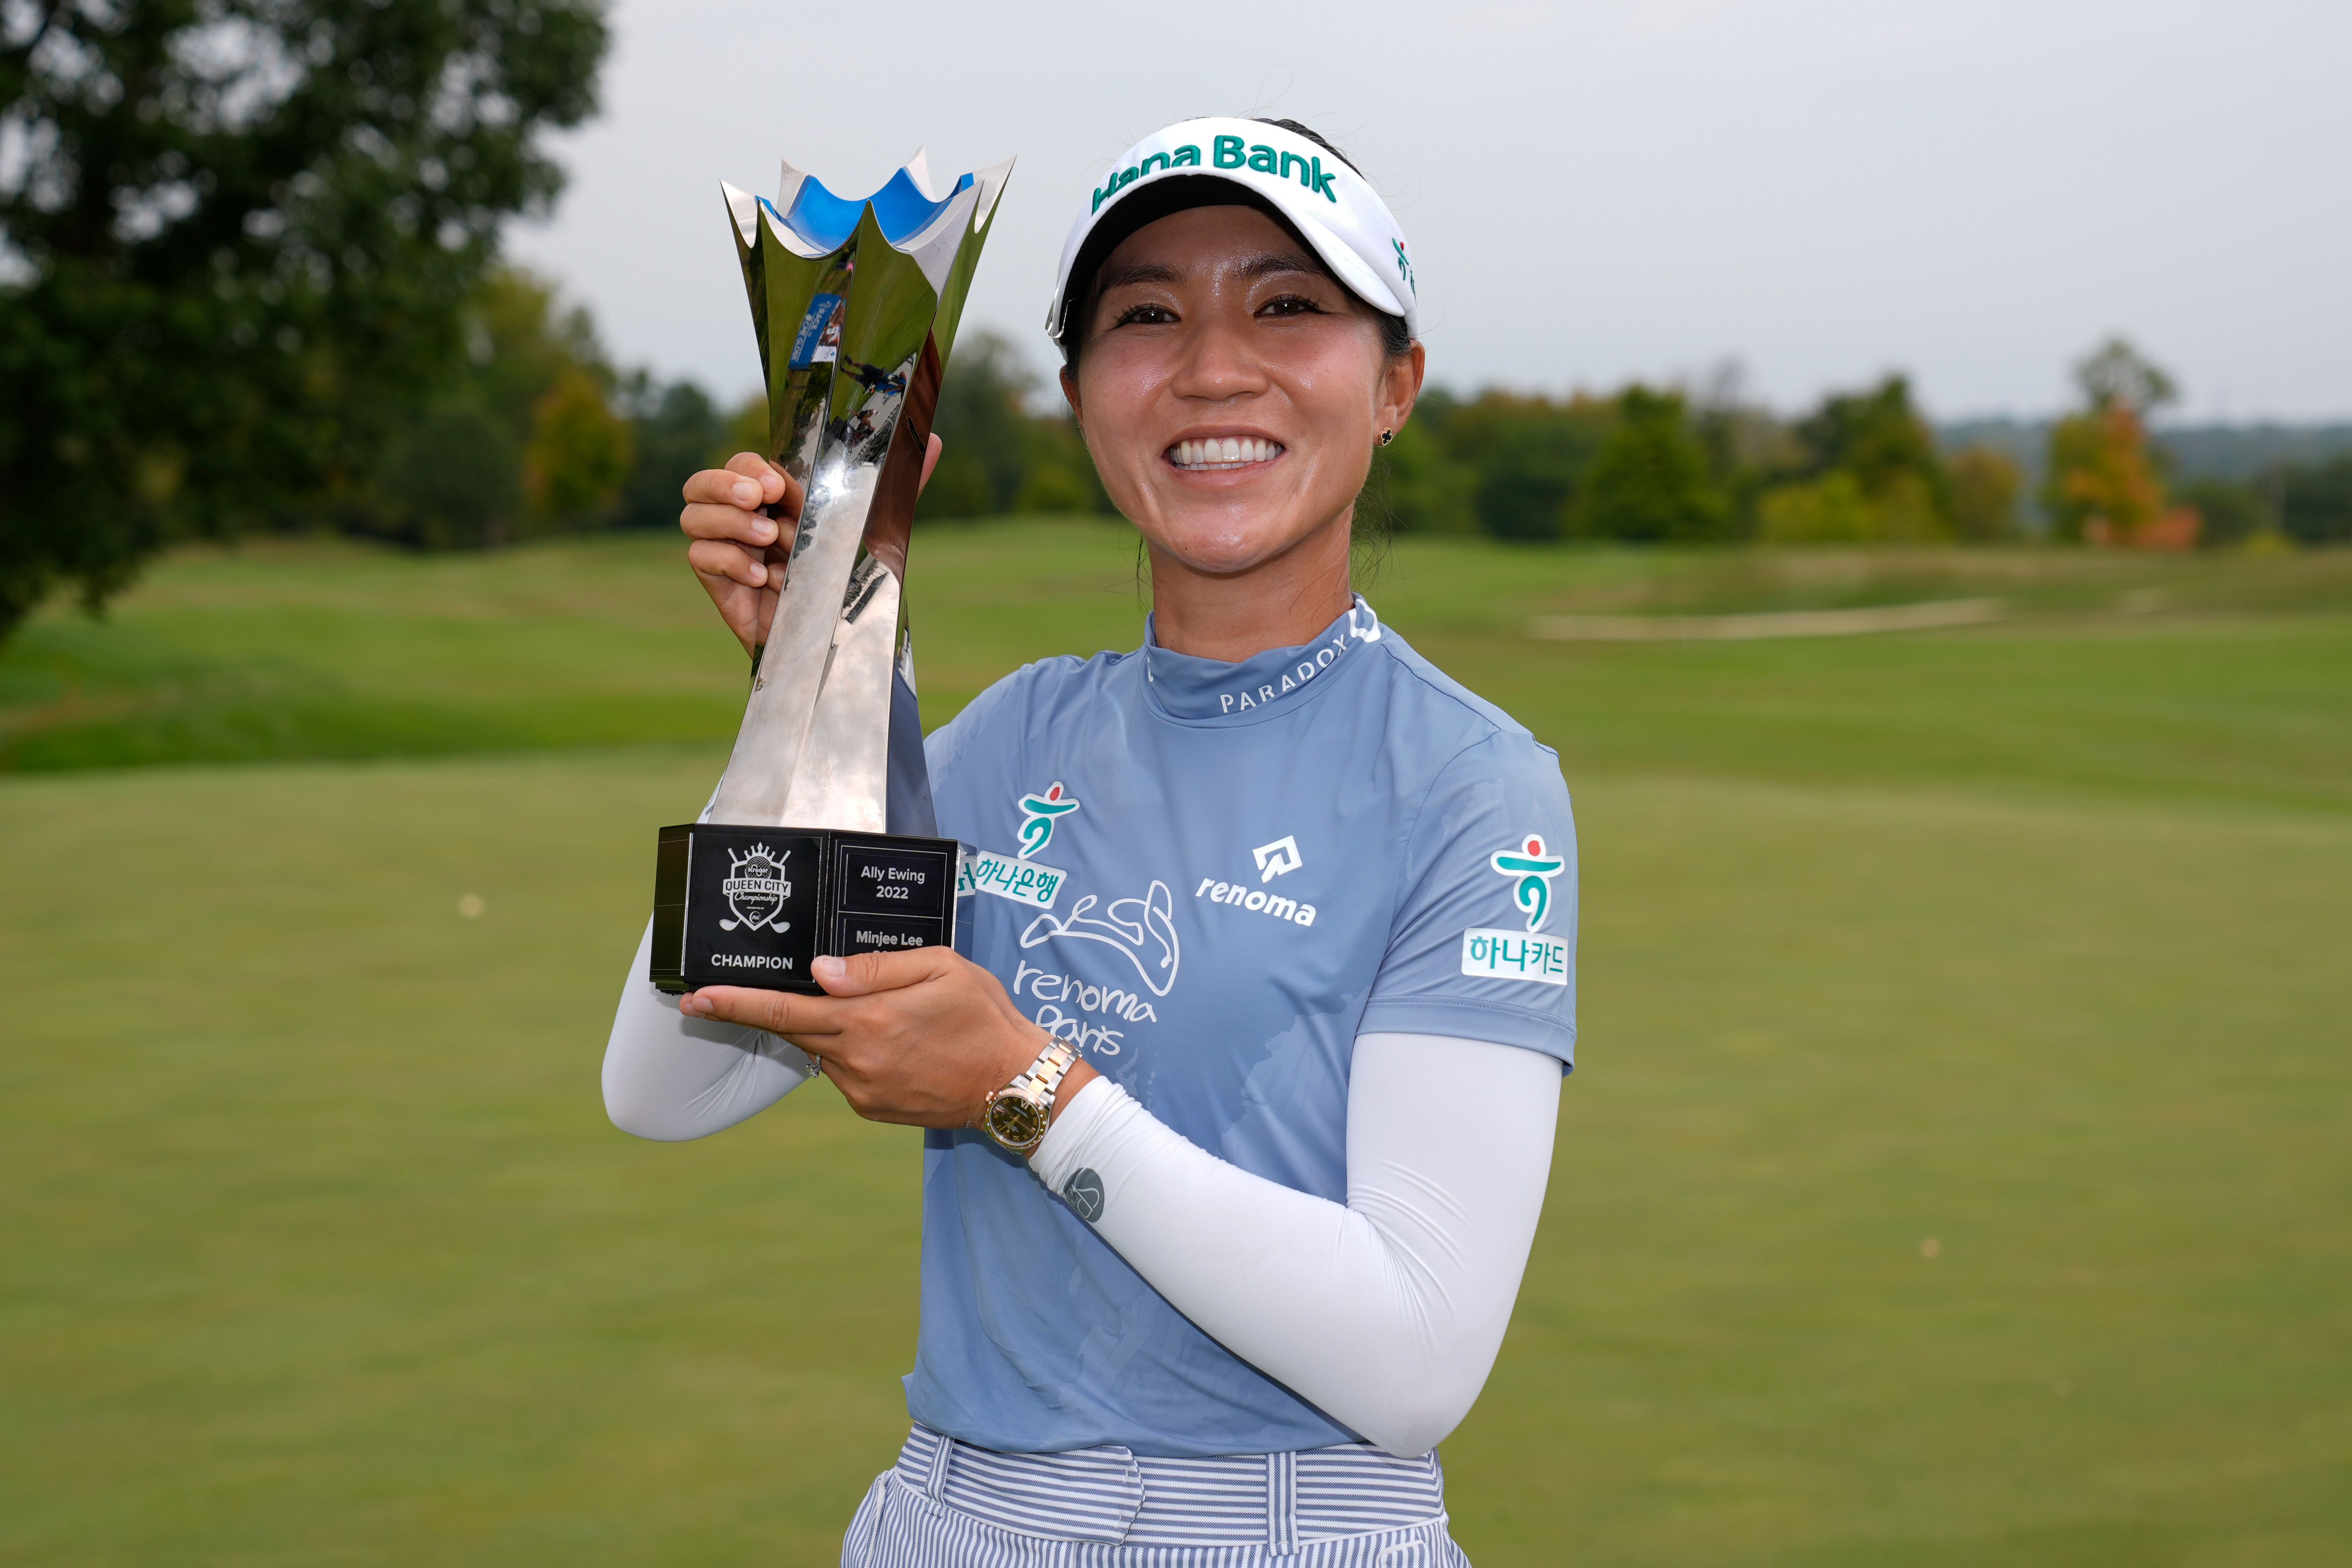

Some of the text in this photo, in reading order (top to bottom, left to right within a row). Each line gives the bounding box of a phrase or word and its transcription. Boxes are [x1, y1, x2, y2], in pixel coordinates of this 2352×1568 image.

[1091, 134, 1337, 218] Hana Bank
[1220, 634, 1347, 713] PARADOX
[748, 864, 769, 877] Kroger
[860, 866, 925, 884] Ally Ewing
[726, 880, 788, 893] QUEEN CITY
[976, 859, 1059, 902] 하나은행
[734, 891, 778, 905] Championship
[876, 886, 908, 899] 2022
[1195, 878, 1316, 927] renoma
[856, 930, 923, 947] Minjee Lee
[711, 954, 793, 969] CHAMPION
[1470, 936, 1563, 974] 하나카드
[1013, 960, 1157, 1022] renoma
